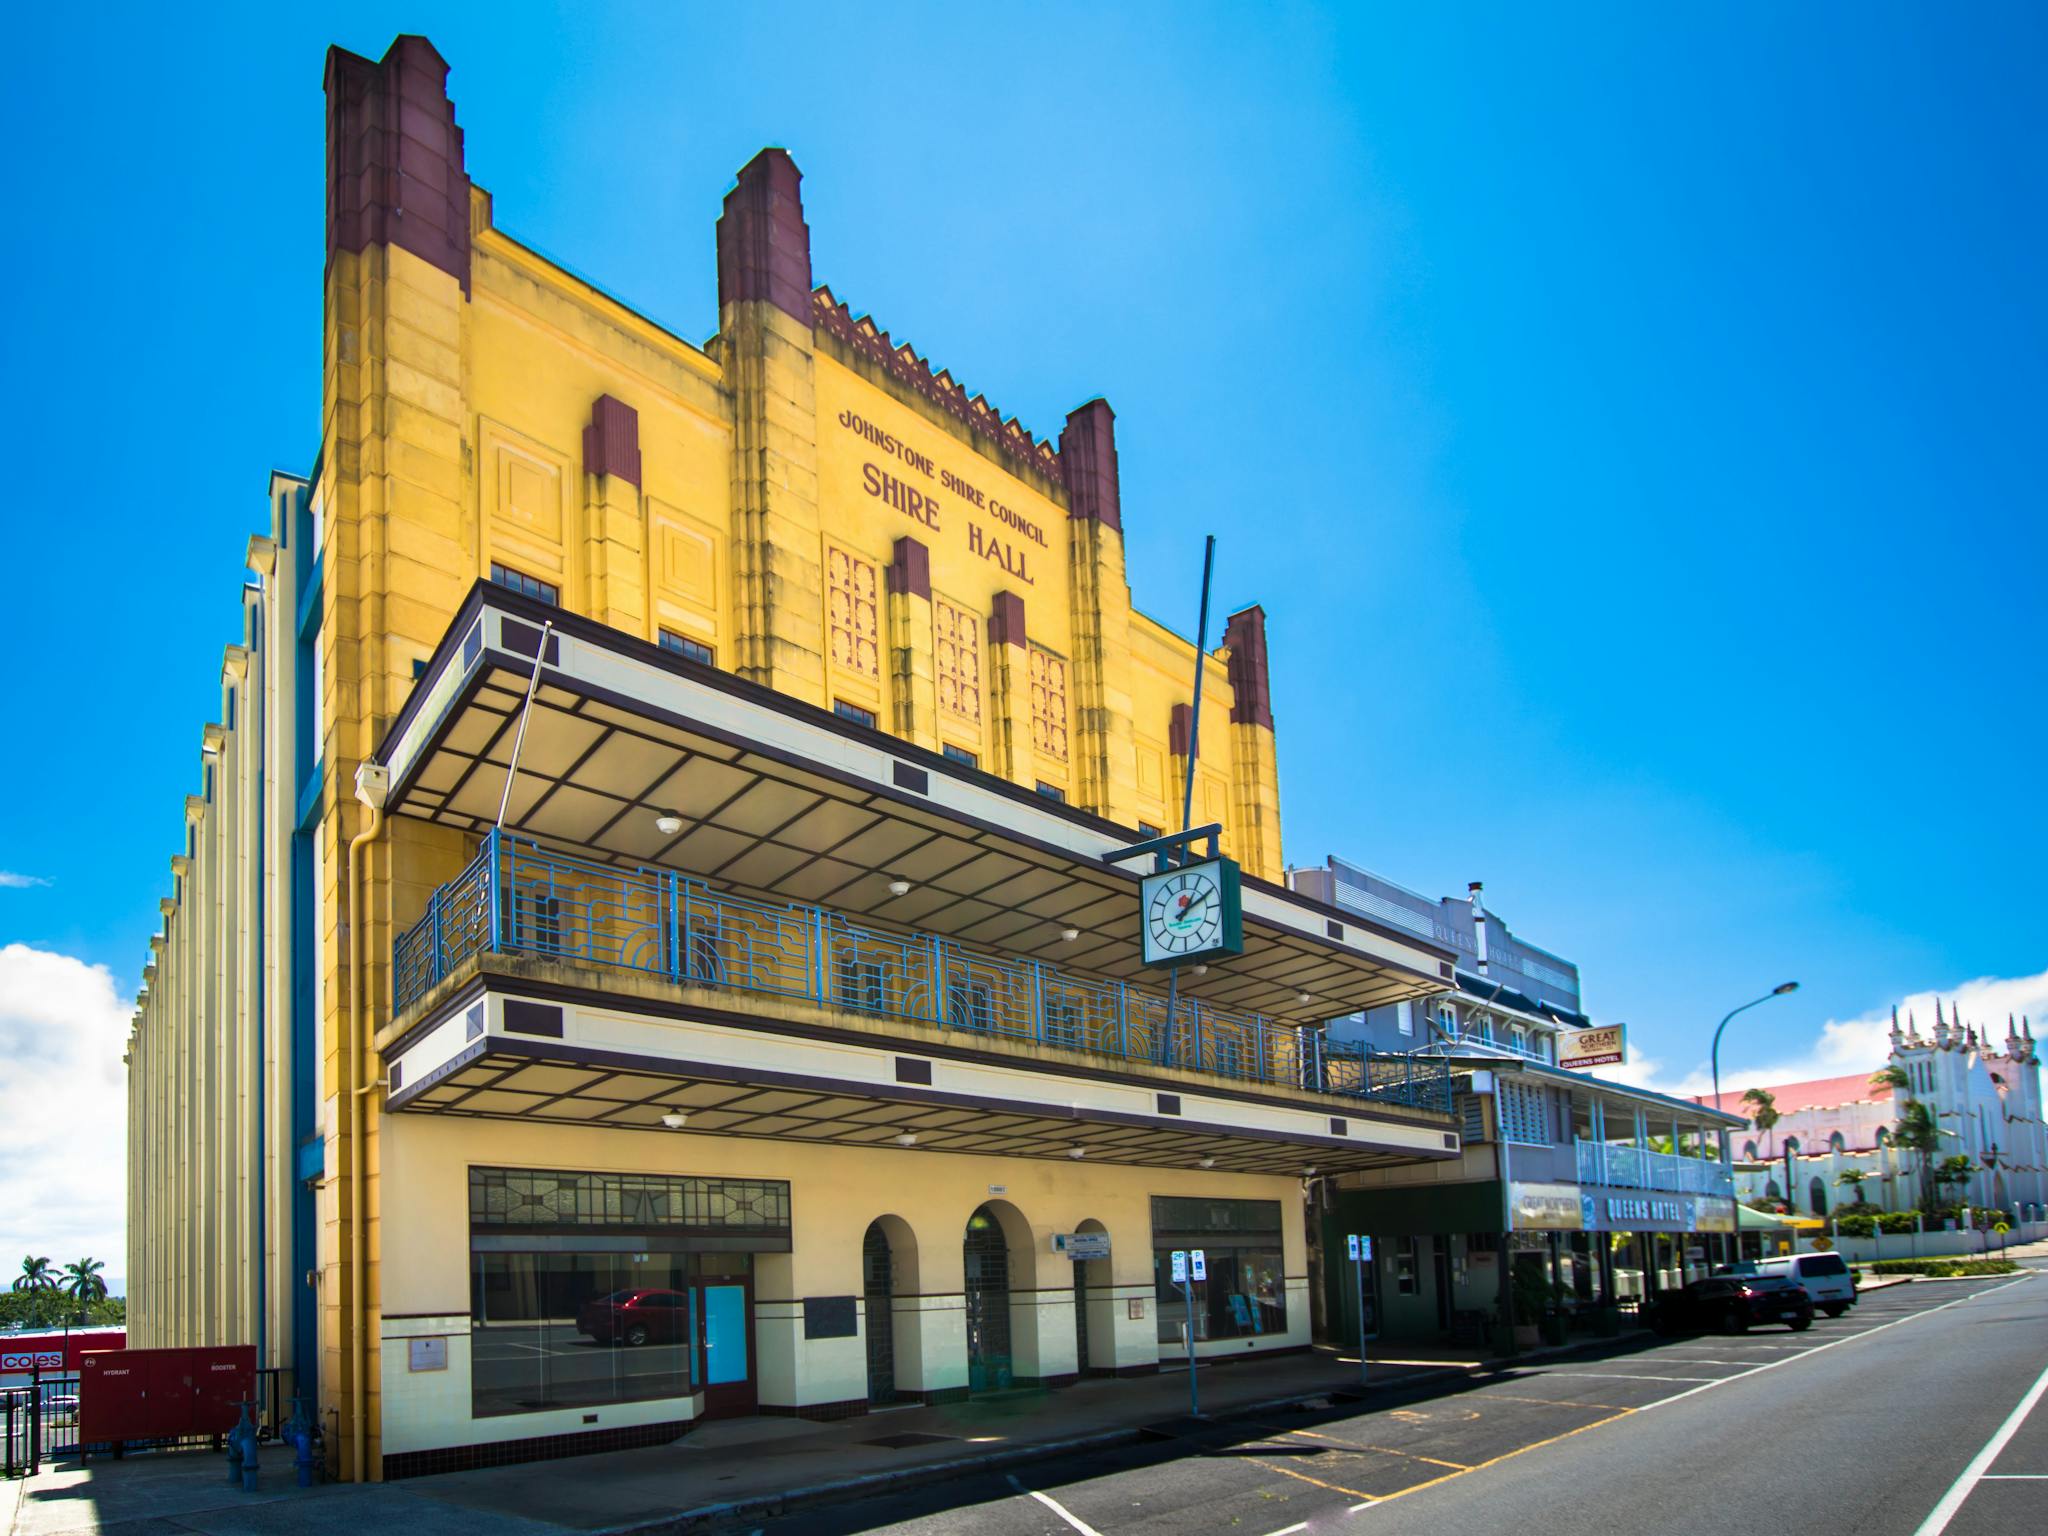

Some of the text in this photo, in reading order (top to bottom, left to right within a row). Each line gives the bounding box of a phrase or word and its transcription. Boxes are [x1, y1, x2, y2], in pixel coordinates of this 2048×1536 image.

[838, 410, 1049, 549] JOHNSTONE SHIRE COUNCIL
[862, 462, 1035, 586] SHIRE HALL
[1579, 1031, 1617, 1045] GREAT
[1580, 1040, 1617, 1050] NORTHERN
[1562, 1055, 1619, 1068] QUEENS HOTEL
[1607, 1197, 1680, 1222] QUEENS HOTEL
[1173, 1252, 1184, 1261] 2P
[1195, 1251, 1201, 1259] P
[3, 1353, 61, 1368] coles
[103, 1368, 130, 1376] HYDRANT
[210, 1364, 237, 1372] BOOSTER
